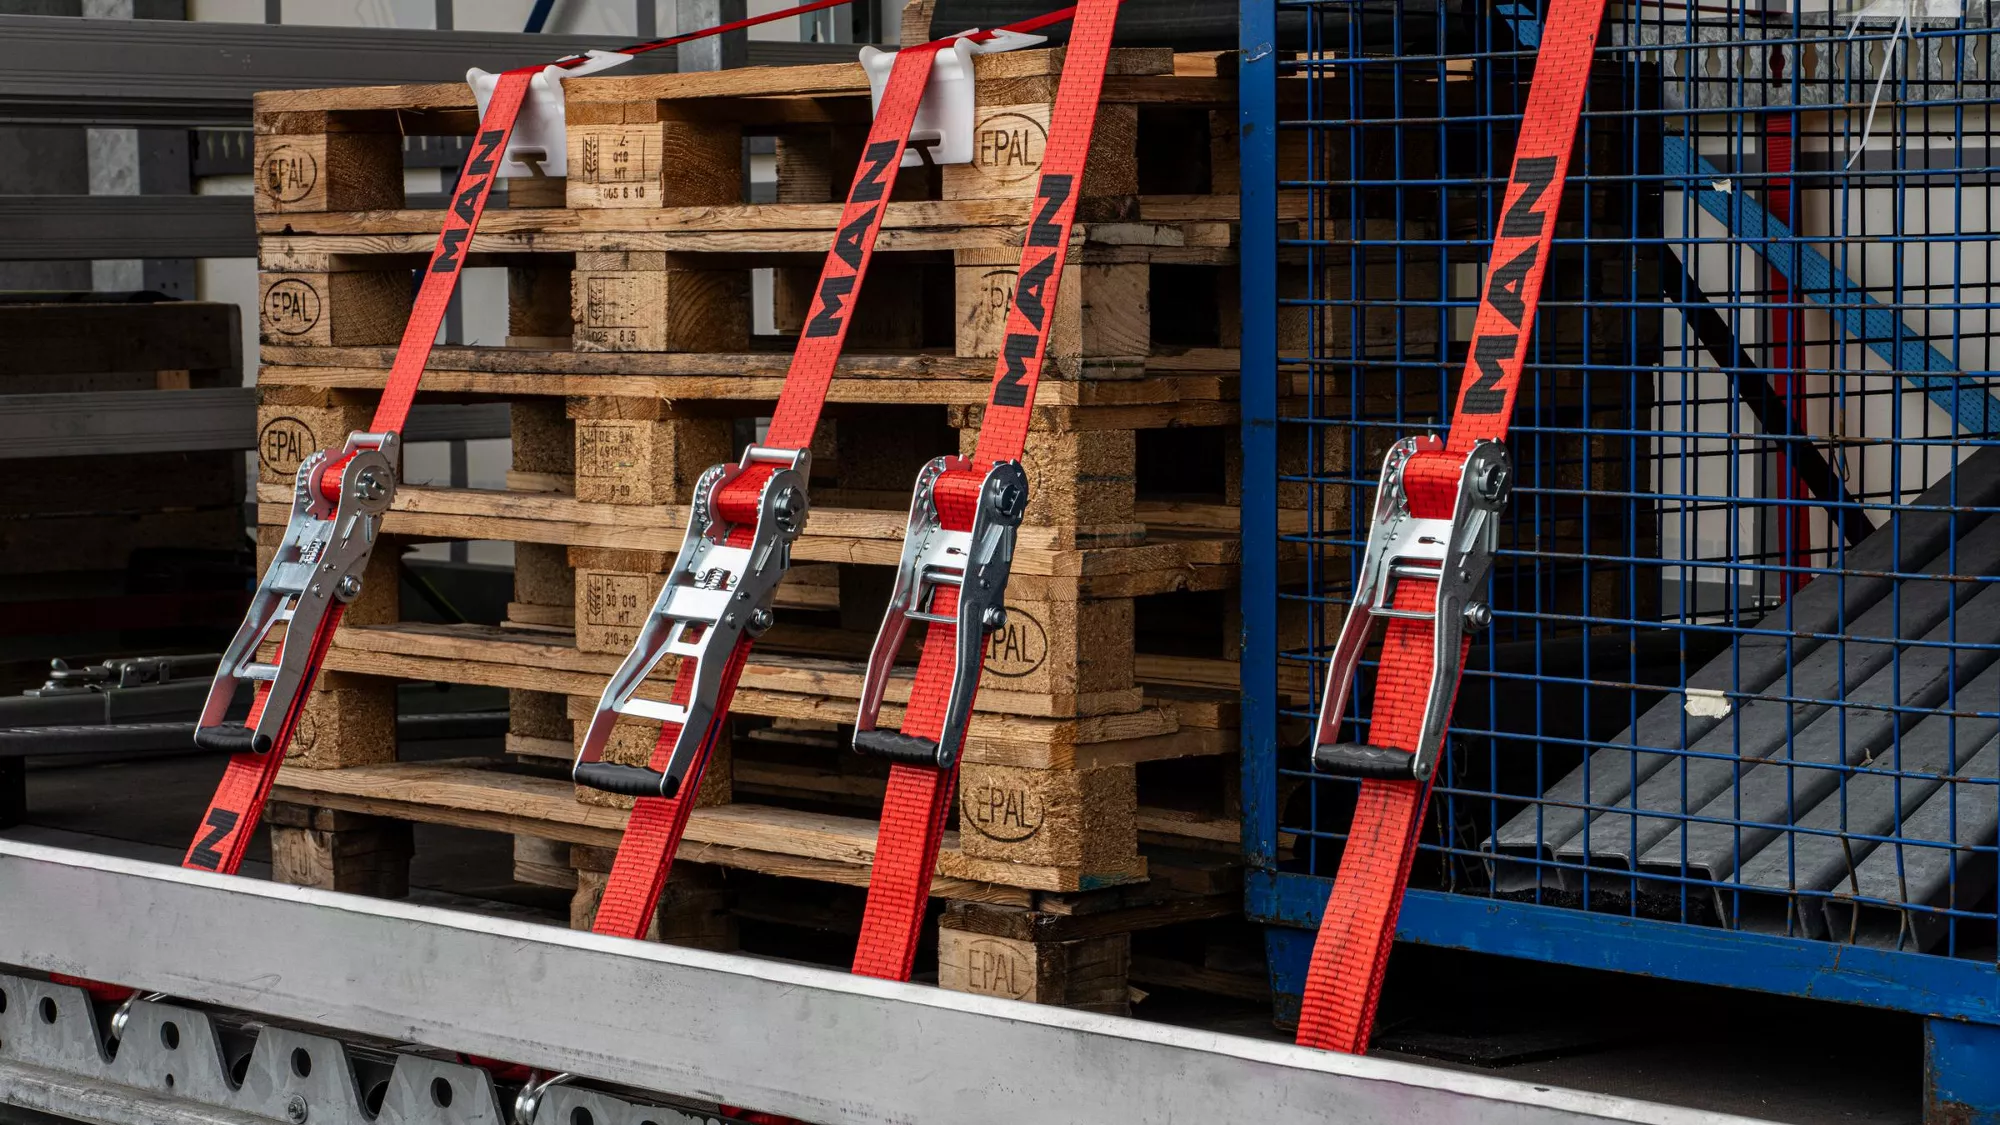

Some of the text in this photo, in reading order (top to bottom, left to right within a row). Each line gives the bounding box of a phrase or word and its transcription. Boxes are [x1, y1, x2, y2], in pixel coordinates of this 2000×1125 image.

[980, 129, 1037, 167] EPAL
[268, 157, 309, 193] EPAL
[431, 129, 505, 273] MAN
[805, 139, 899, 338] MAN
[992, 174, 1073, 407] MAN
[1461, 155, 1558, 414] MAN
[272, 291, 313, 322] EPAL
[268, 430, 307, 463] EPAL
[606, 593, 637, 608] 30 013
[618, 611, 630, 623] HT
[985, 624, 1036, 664] PAL
[977, 786, 1034, 829] EPAL
[968, 950, 1020, 995] EPAL
